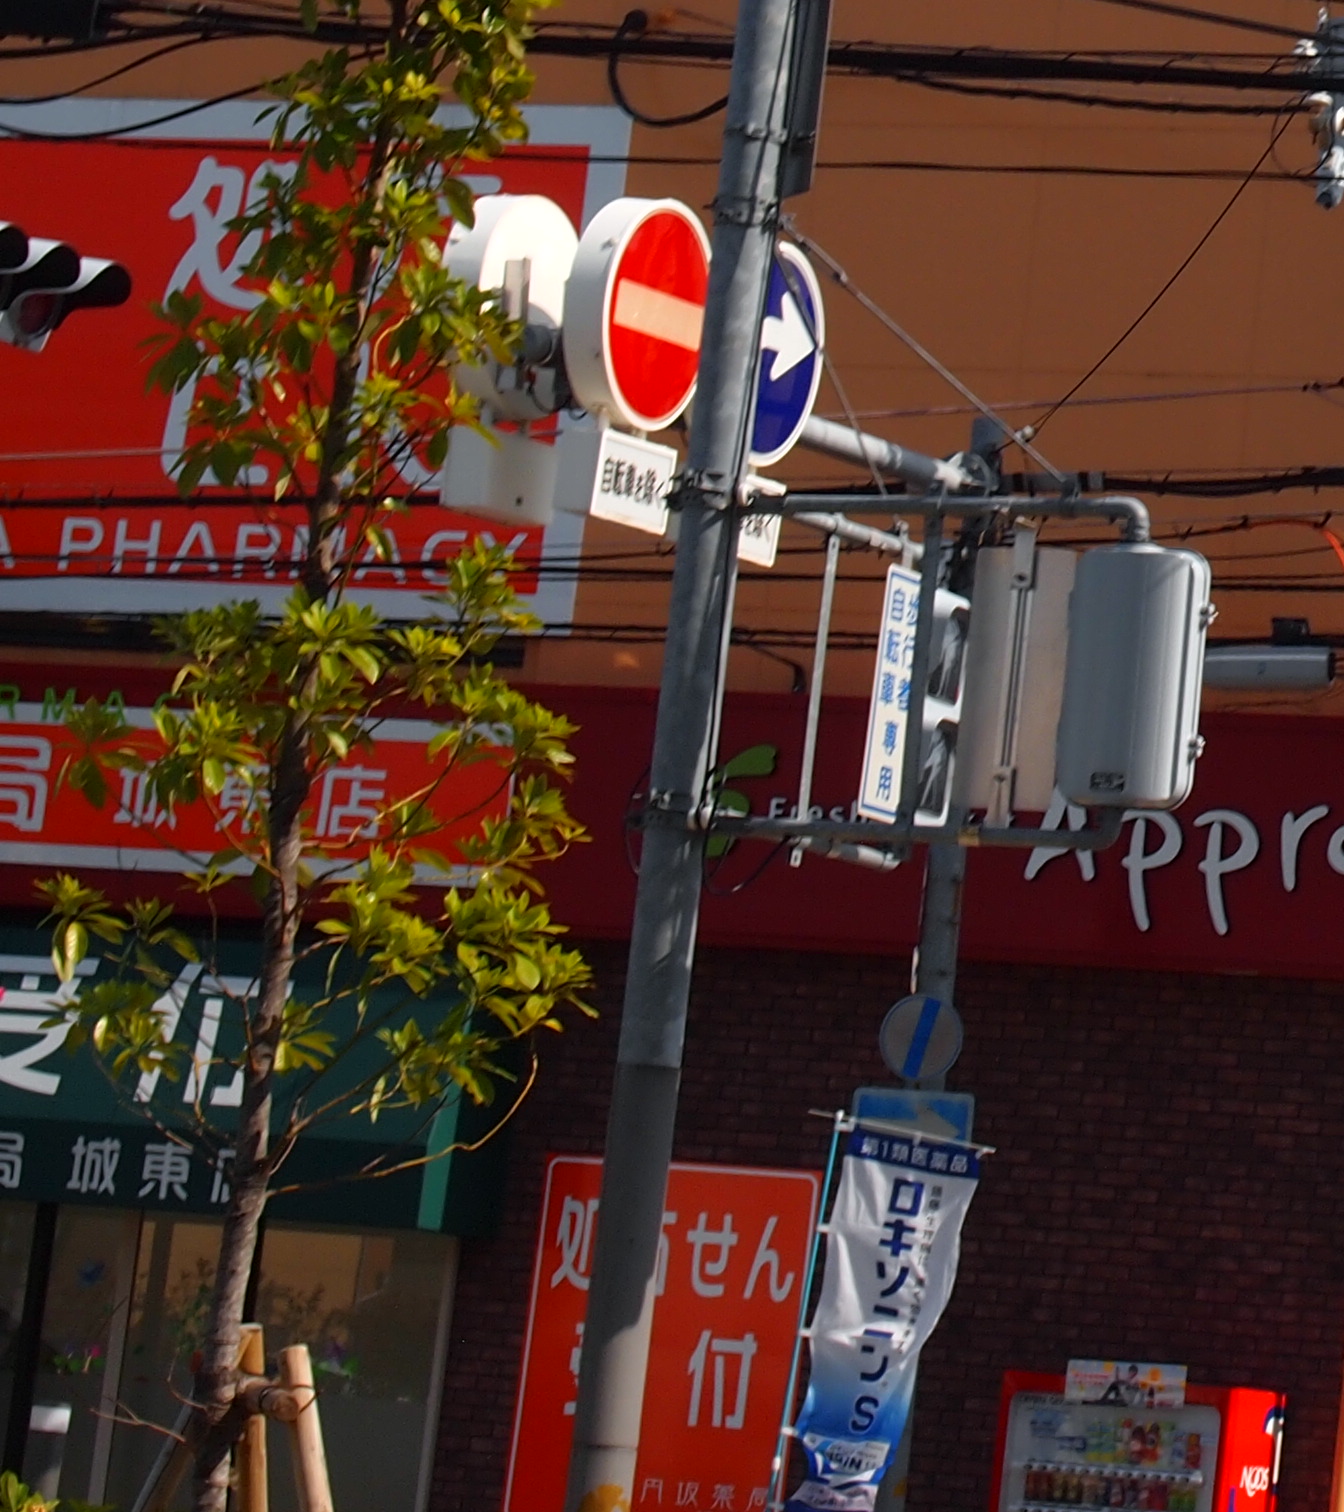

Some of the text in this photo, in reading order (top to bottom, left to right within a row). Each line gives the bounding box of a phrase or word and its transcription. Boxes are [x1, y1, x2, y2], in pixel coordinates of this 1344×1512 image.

[875, 588, 905, 802] 自転車専用
[860, 1135, 968, 1175] 第1類医薬品
[551, 1194, 795, 1305] 処せん
